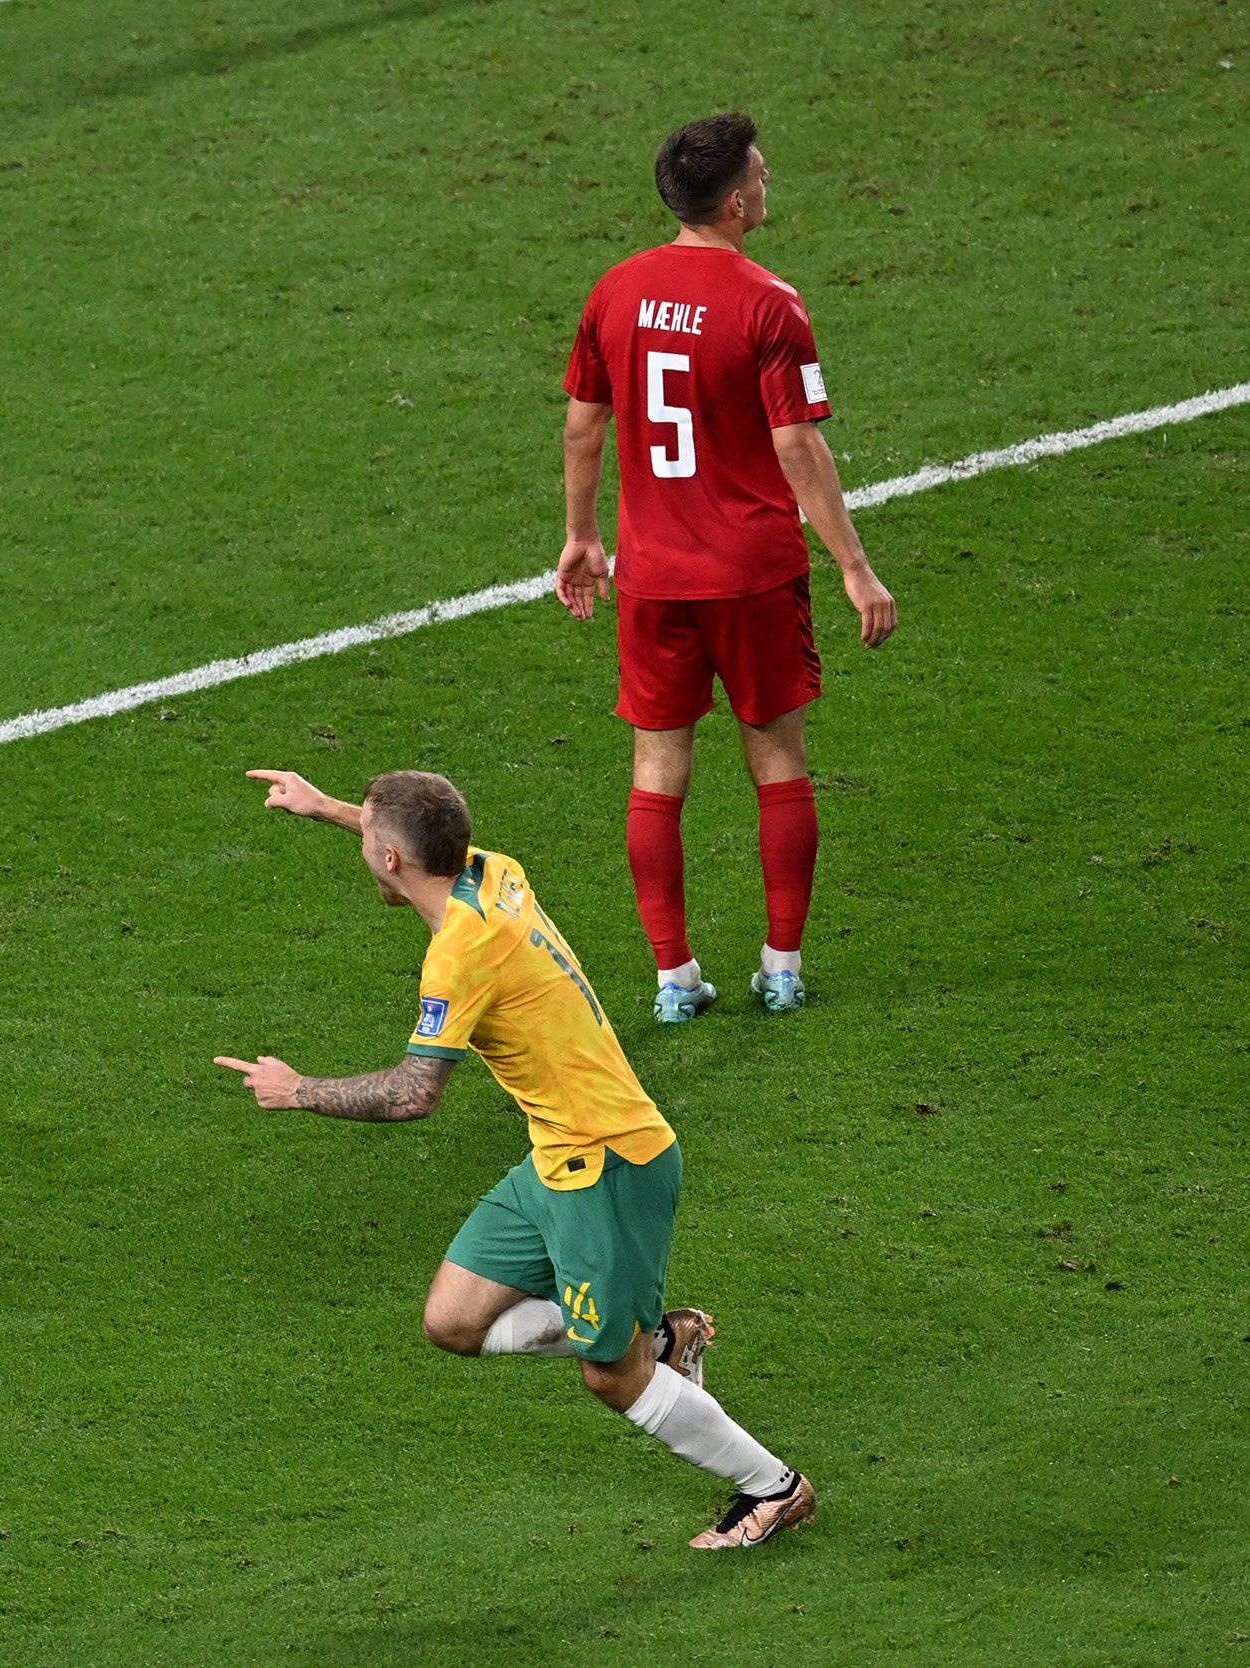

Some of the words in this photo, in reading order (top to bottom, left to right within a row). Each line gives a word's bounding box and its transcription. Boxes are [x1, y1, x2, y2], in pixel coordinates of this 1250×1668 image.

[638, 299, 707, 335] MÆHLE
[647, 351, 696, 478] 5
[564, 1282, 600, 1331] 14
